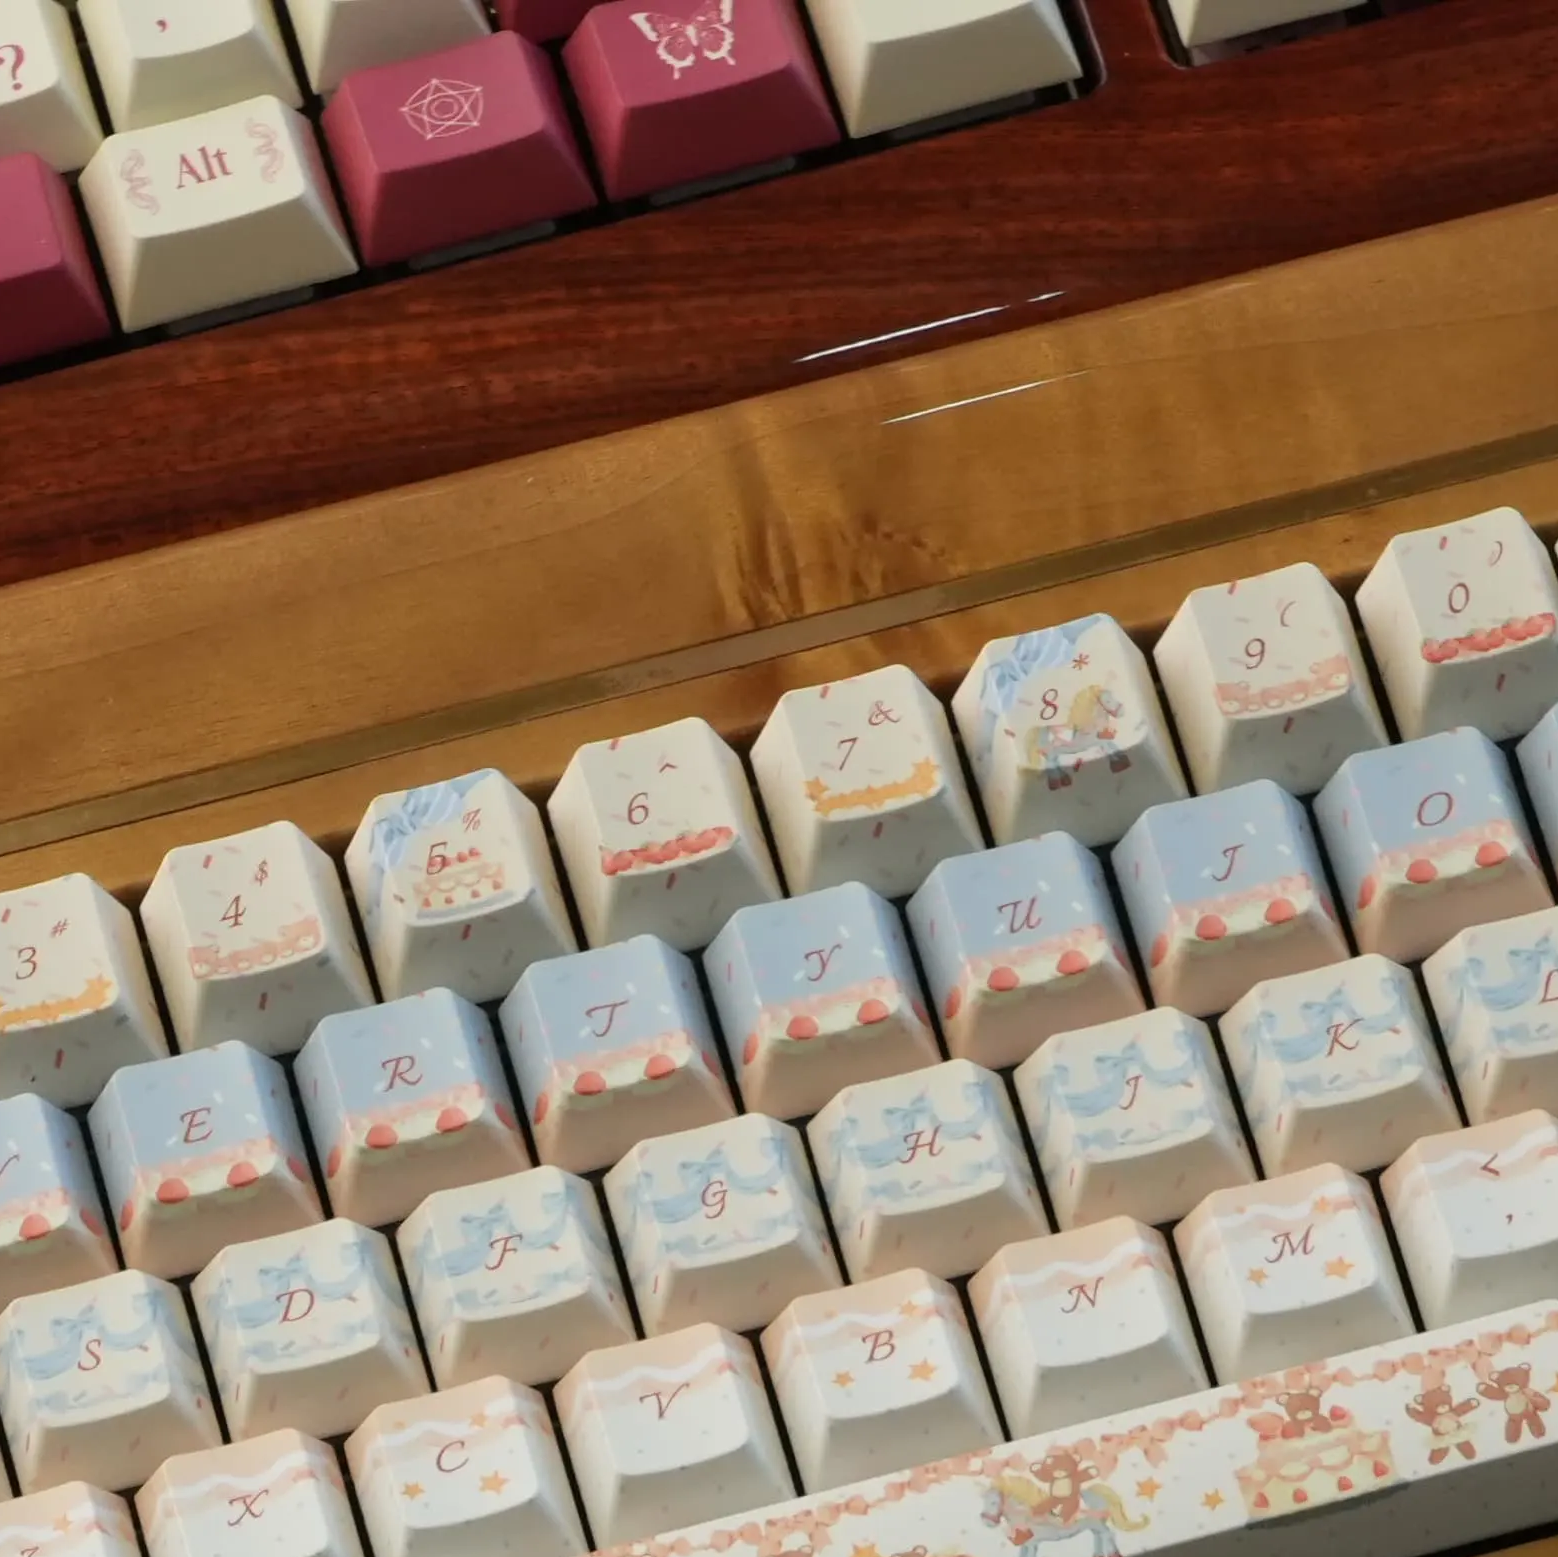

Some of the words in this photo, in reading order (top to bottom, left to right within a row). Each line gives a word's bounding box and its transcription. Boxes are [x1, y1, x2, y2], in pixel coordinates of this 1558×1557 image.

[175, 144, 234, 191] Alt
[1415, 792, 1455, 827] O
[381, 1055, 423, 1094] R
[897, 1130, 945, 1165] H
[1263, 1229, 1316, 1265] M
[1059, 1278, 1107, 1314] N
[860, 1331, 897, 1365] B
